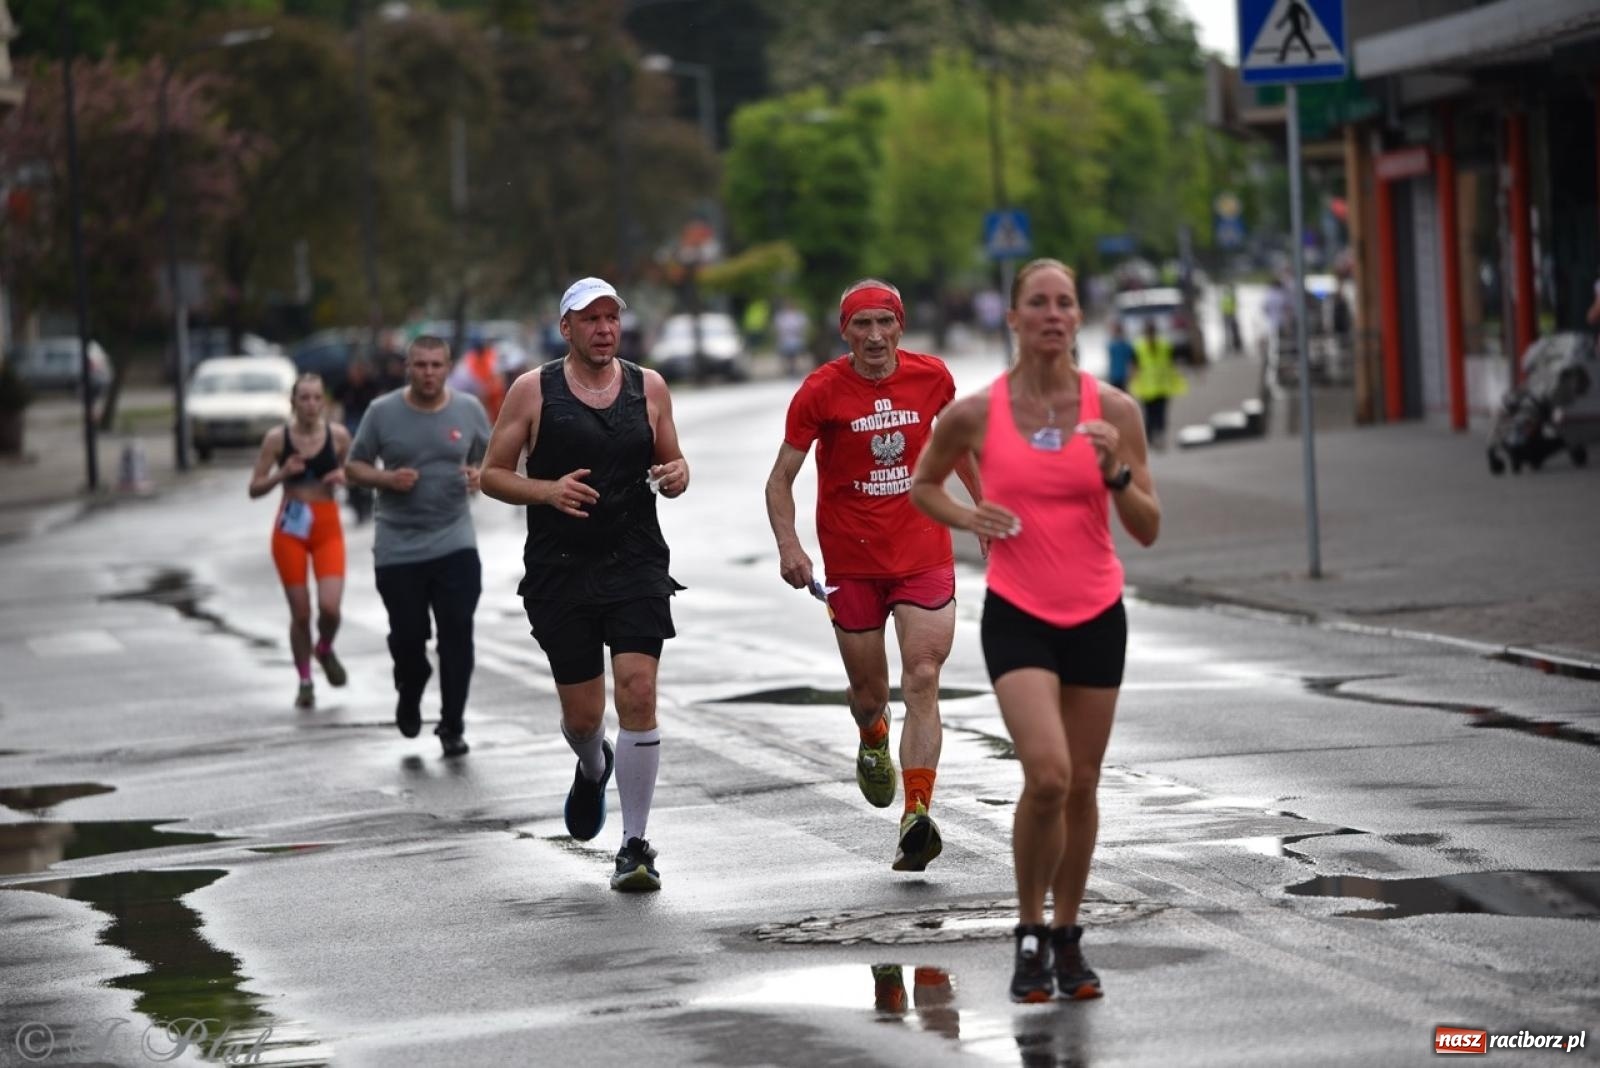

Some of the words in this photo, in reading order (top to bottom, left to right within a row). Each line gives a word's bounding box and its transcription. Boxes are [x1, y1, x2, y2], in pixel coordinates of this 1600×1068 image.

[874, 398, 892, 412] OD
[851, 410, 920, 432] URODZENIA
[869, 465, 909, 481] DUMNI
